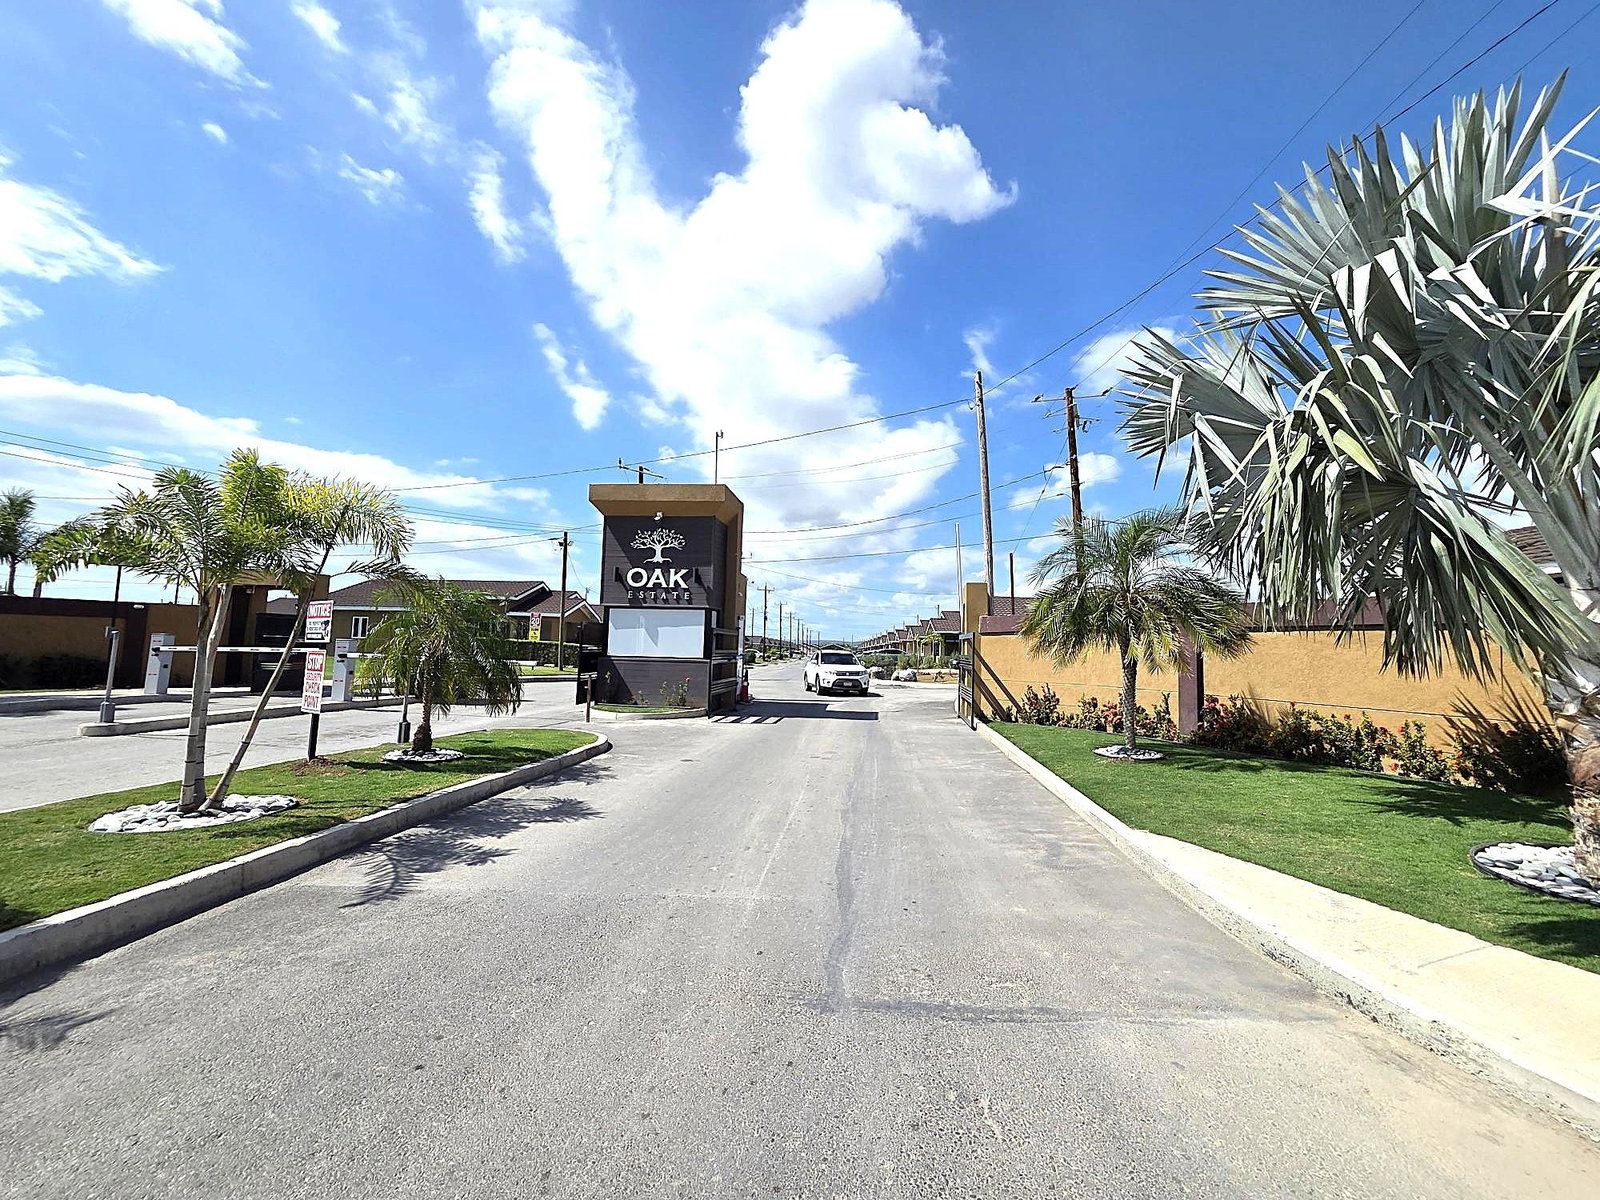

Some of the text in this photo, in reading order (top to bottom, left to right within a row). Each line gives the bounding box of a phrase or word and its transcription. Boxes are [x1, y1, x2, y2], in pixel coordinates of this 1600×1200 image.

[626, 567, 689, 588] OAK
[627, 590, 691, 600] ESTATE
[308, 604, 331, 617] NOTICE
[531, 617, 540, 625] 20
[307, 654, 324, 670] STOP
[305, 681, 321, 694] CHECK
[304, 694, 320, 709] POINT
